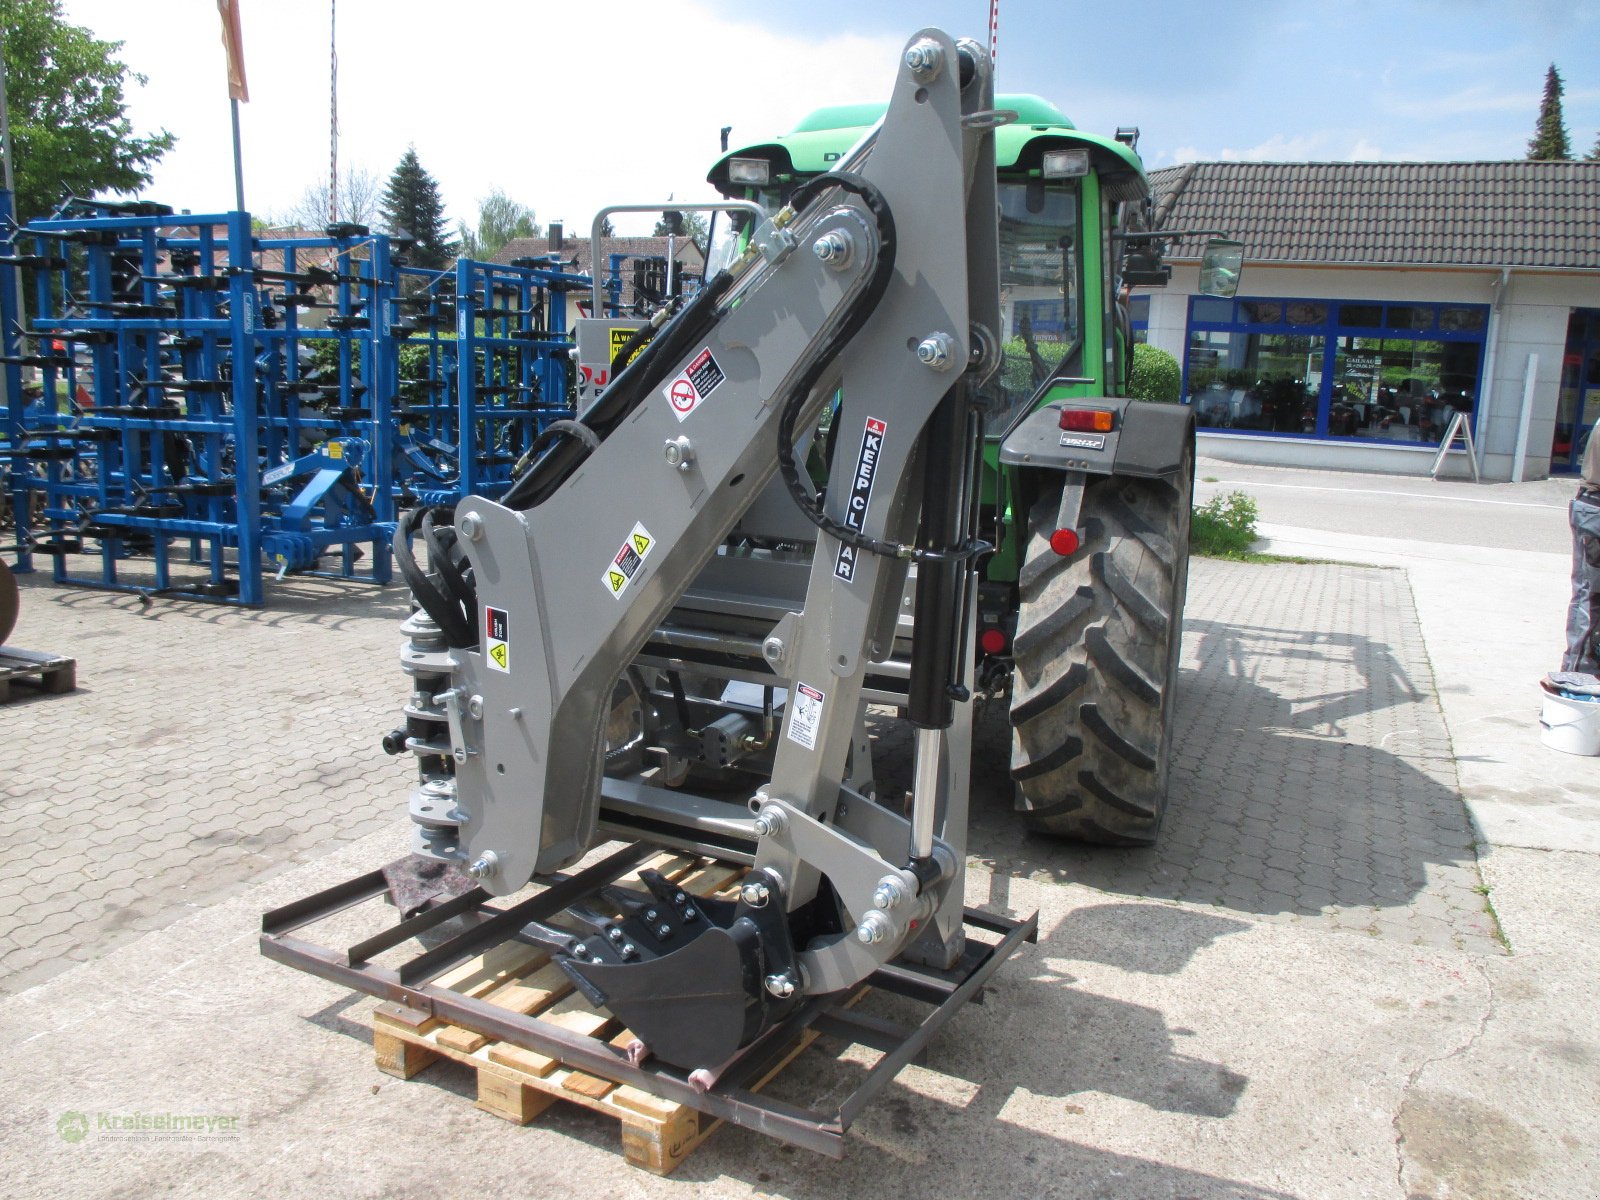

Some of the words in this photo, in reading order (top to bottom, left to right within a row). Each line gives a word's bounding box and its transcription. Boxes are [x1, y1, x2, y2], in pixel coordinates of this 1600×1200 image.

[693, 353, 708, 370] DANGER
[856, 434, 880, 490] KEEP
[838, 496, 865, 577] CLAR
